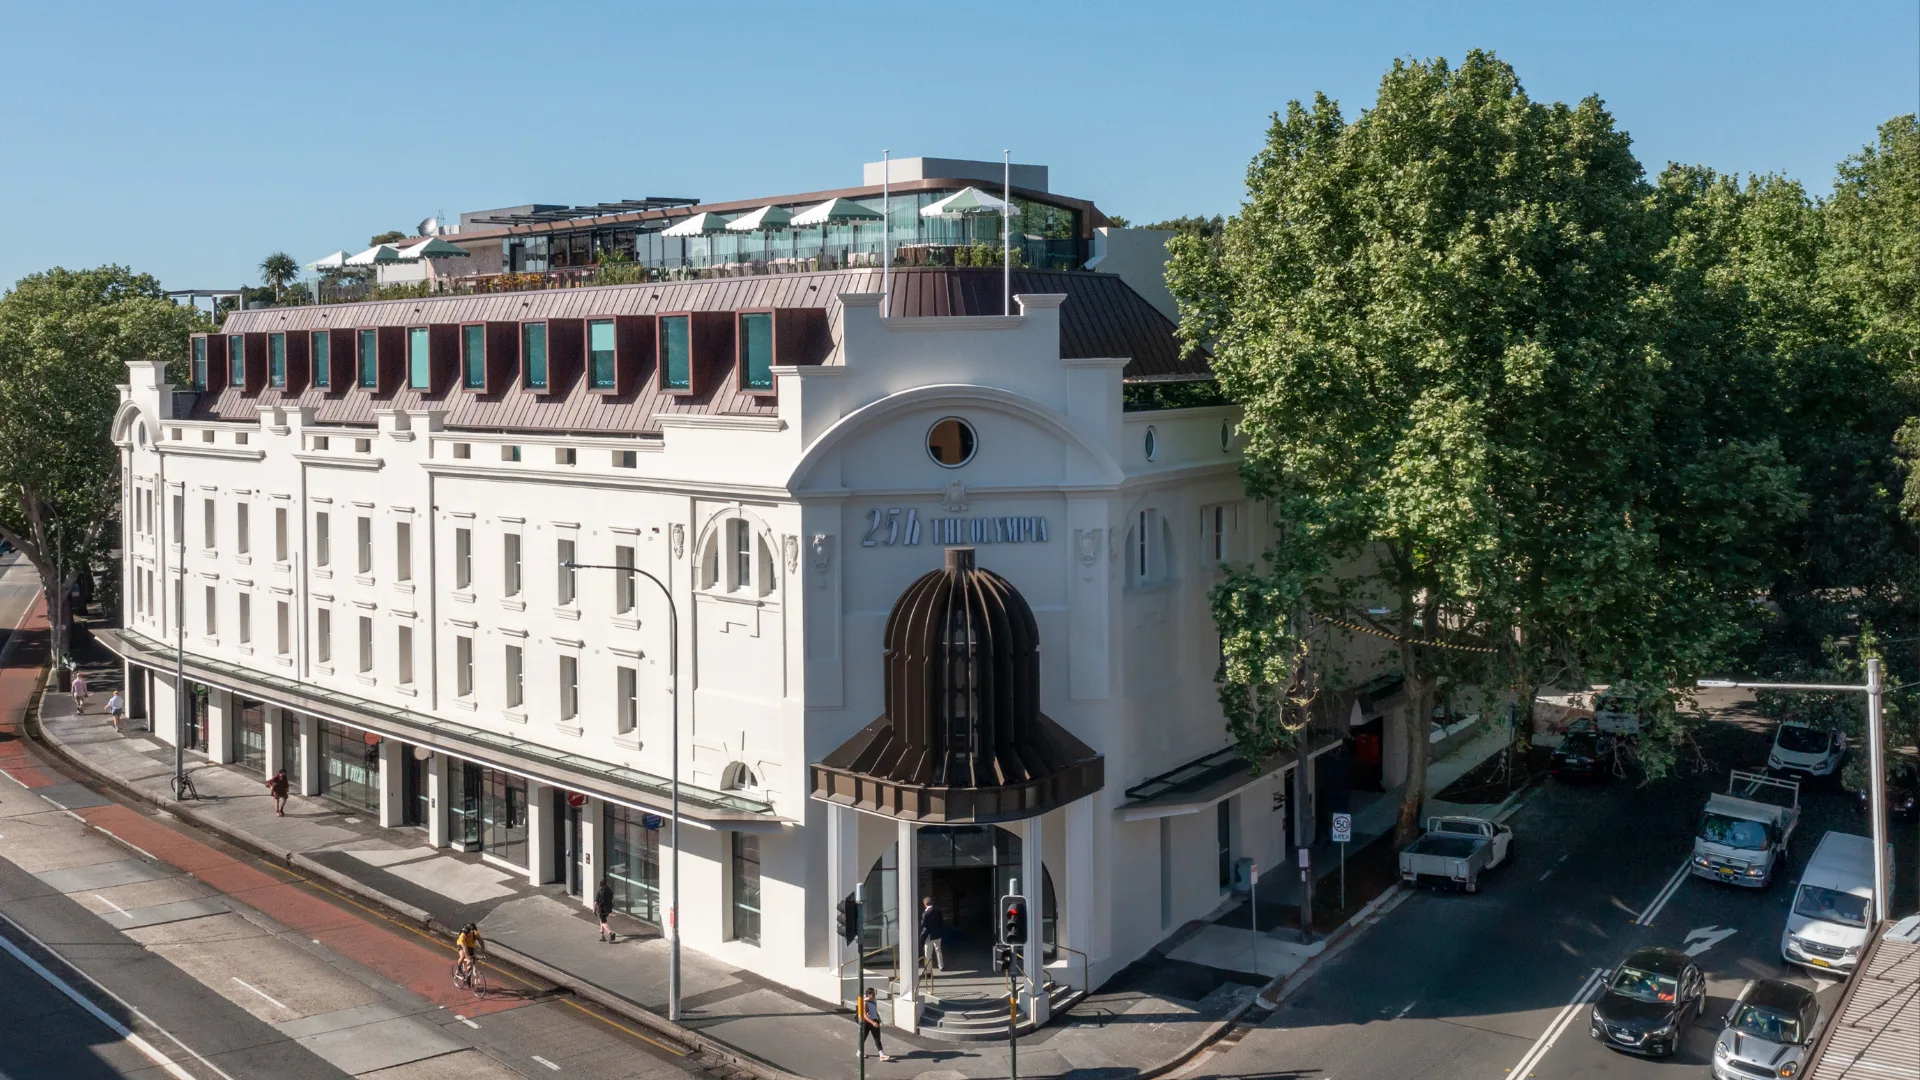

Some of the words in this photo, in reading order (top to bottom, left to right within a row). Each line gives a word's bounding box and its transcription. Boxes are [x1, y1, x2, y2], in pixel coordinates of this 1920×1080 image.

[862, 508, 921, 547] 25h
[931, 518, 965, 545] THE
[970, 516, 1048, 543] OLYMPIA
[1336, 820, 1348, 829] 50
